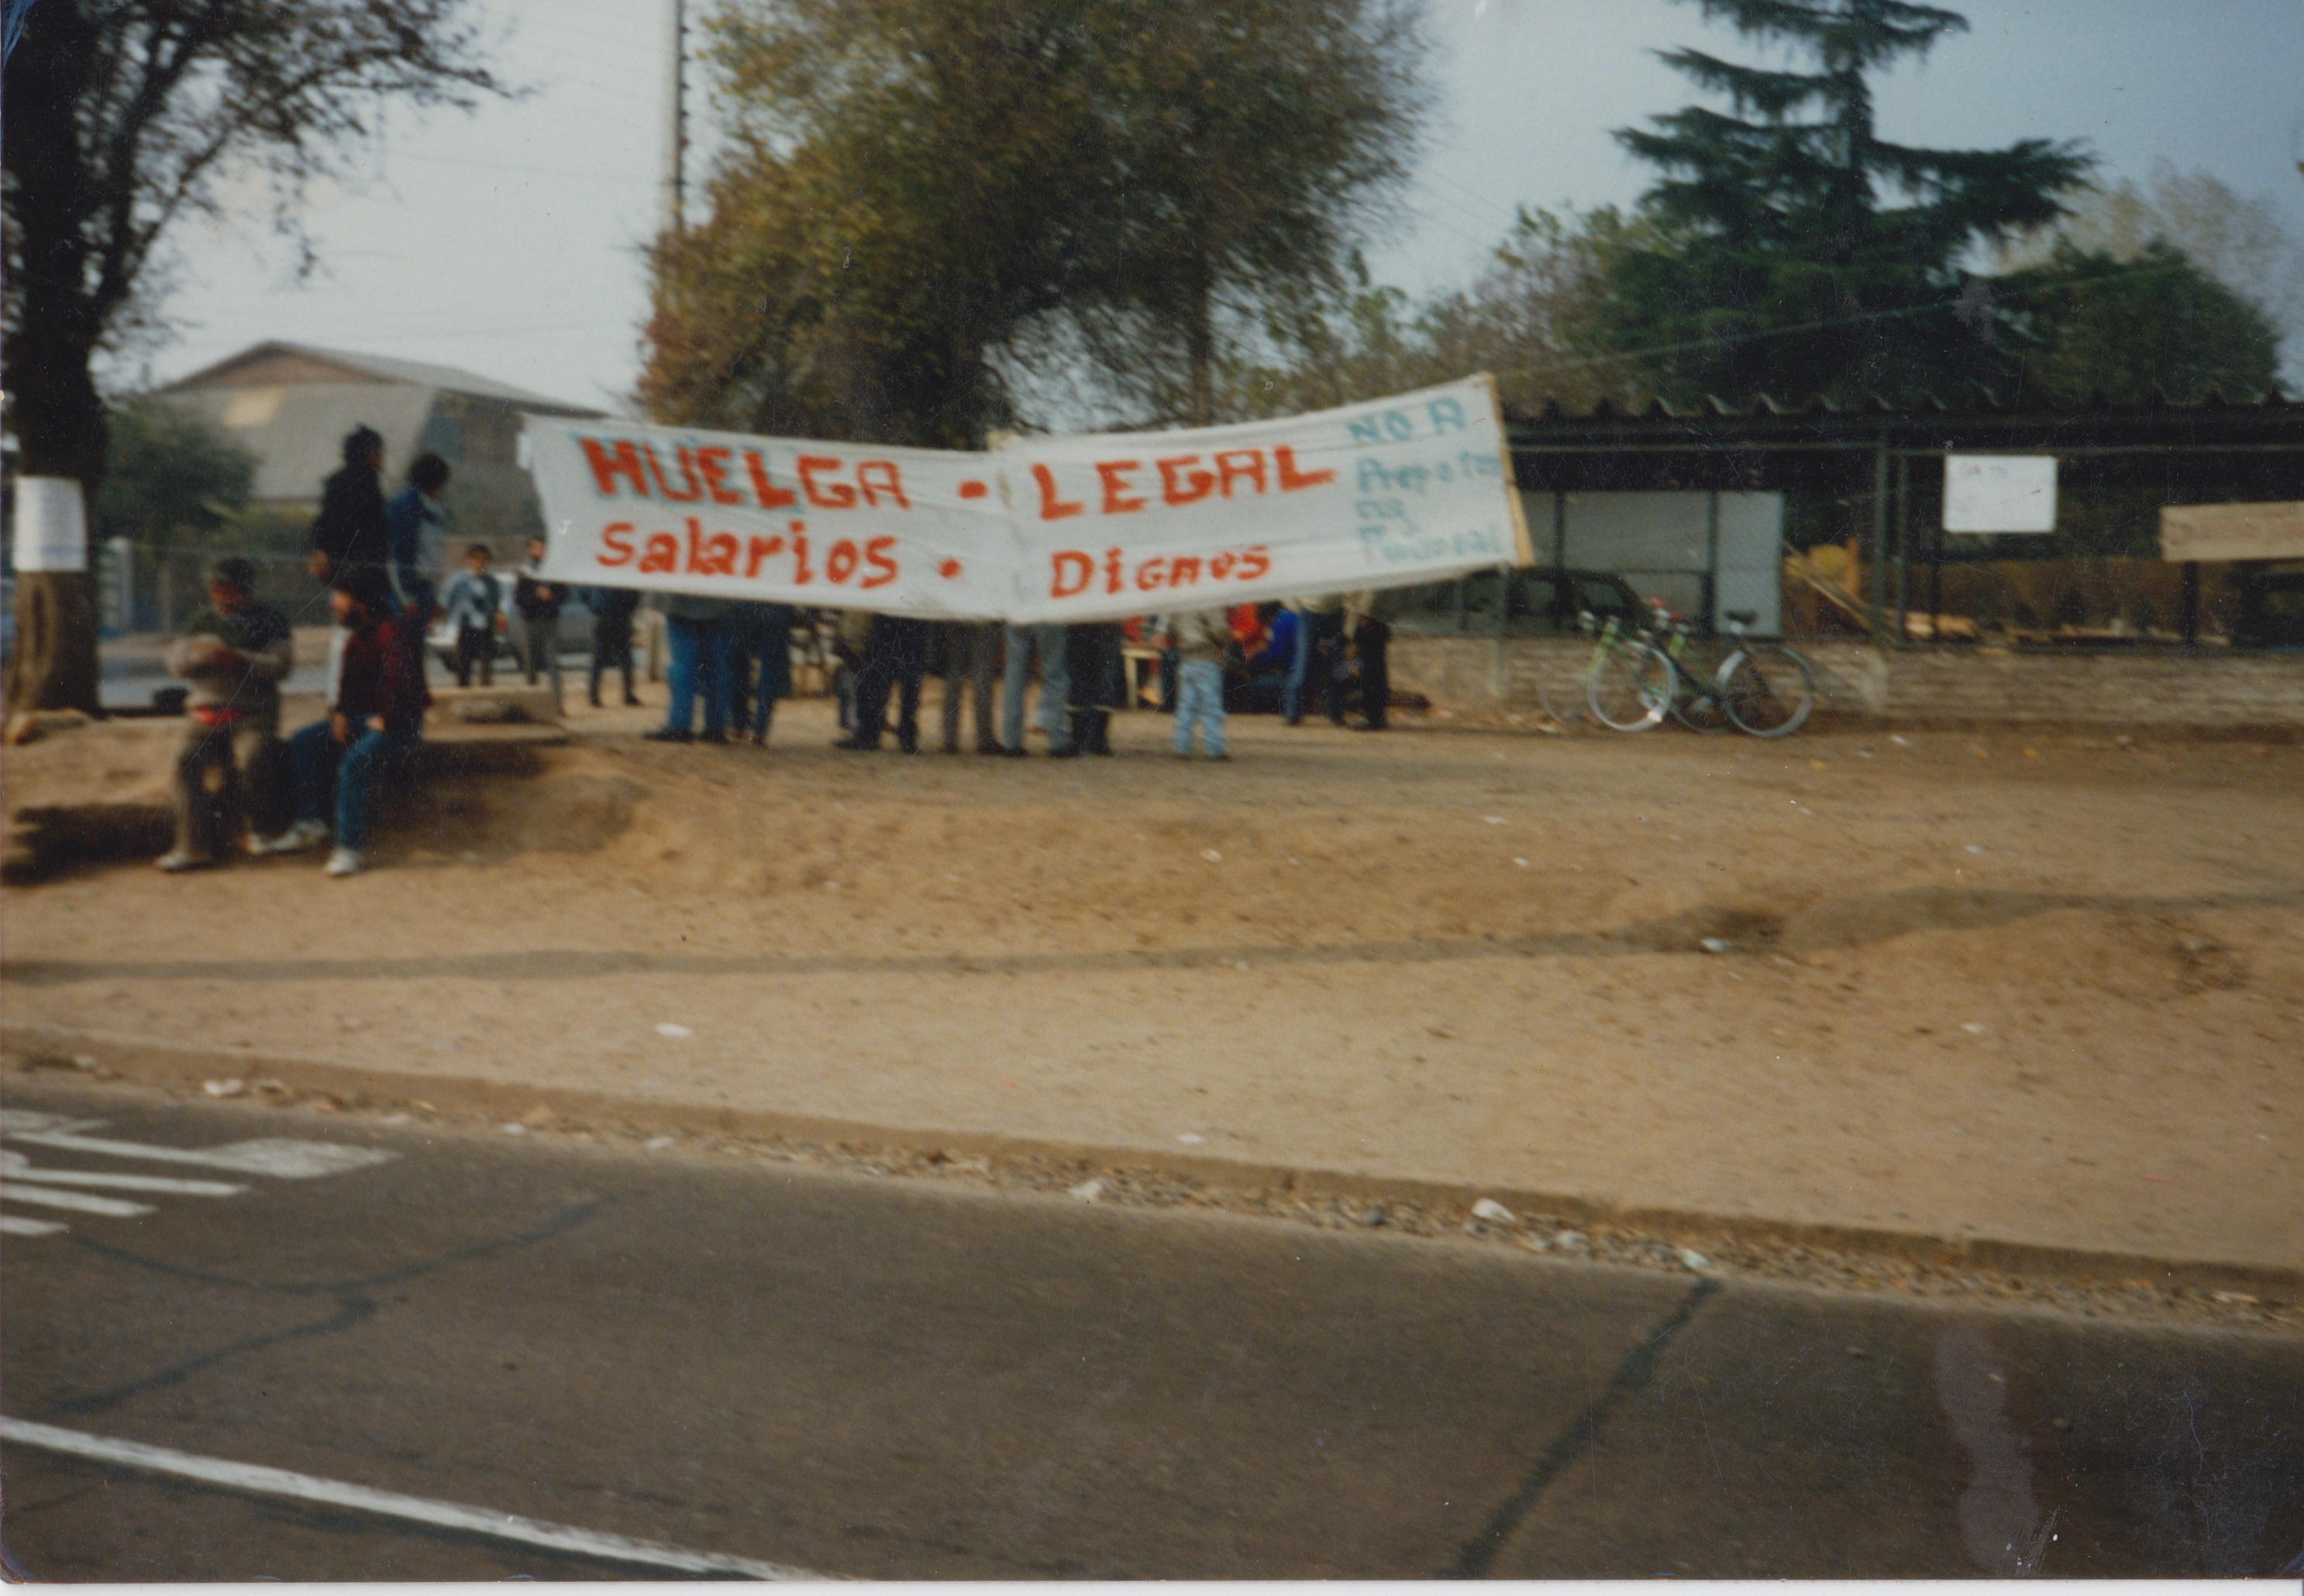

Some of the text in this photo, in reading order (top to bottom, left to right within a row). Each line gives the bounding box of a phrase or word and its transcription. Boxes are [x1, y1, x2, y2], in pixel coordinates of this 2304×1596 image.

[1346, 396, 1467, 444] NO A
[580, 437, 912, 511] HUELGA
[1030, 443, 1336, 522] LEGAL
[595, 516, 900, 590] Salarios
